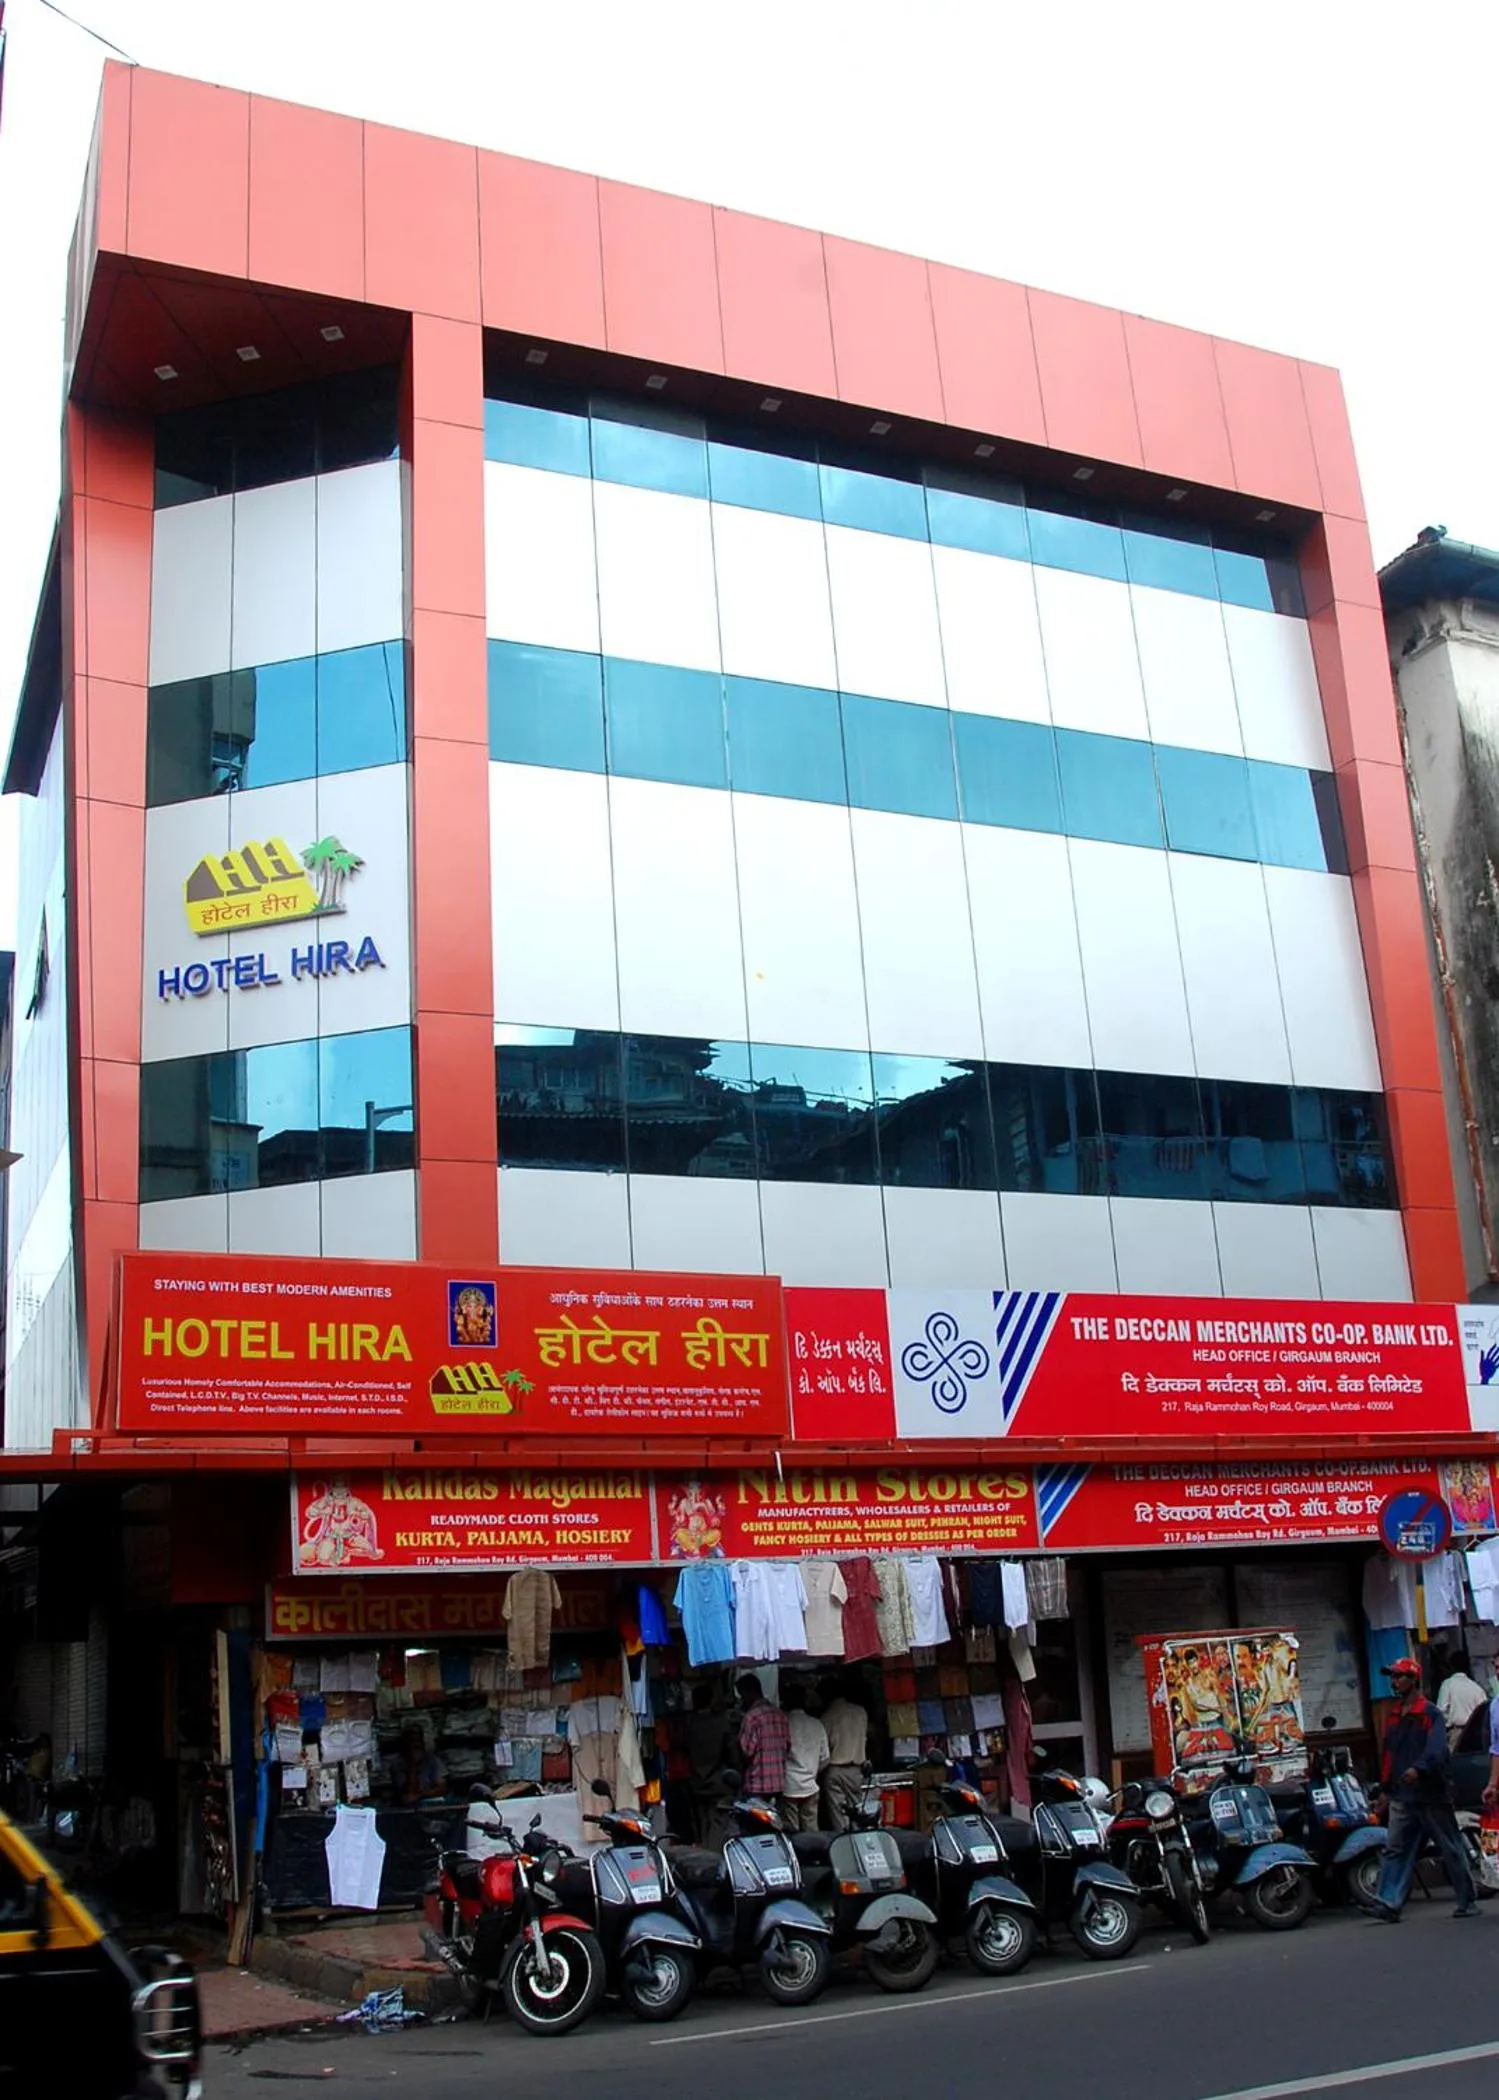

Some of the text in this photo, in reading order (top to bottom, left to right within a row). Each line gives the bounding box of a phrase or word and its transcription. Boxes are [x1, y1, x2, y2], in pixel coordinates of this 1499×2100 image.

[201, 893, 298, 926] होटेल हीरा
[158, 936, 384, 999] HOTEL HIRA
[154, 1278, 392, 1298] STAYING WITH BEST MODERN AMENITIES
[550, 1291, 588, 1308] आधुनिक
[143, 1317, 413, 1361] HOTEL HIRA
[1070, 1317, 1454, 1346] THE DECCAN MERCHANTS CO-OP. BANK LTD.
[534, 1314, 770, 1370] होटेल हीरा
[1193, 1349, 1226, 1362] HEAD
[1229, 1350, 1271, 1362] OFFICE
[1279, 1350, 1333, 1363] GIRGAUM
[1335, 1351, 1381, 1364] BRANCH
[142, 1377, 183, 1386] Luxurious
[184, 1378, 214, 1388] Homely
[215, 1379, 263, 1388] Comfortable
[397, 1382, 411, 1390] Self
[1121, 1372, 1140, 1393] दि
[1144, 1372, 1201, 1393] डेक्कन
[1263, 1373, 1293, 1393] को.
[1368, 1374, 1423, 1394] लिमिटेड
[231, 1391, 245, 1401] Big
[150, 1403, 175, 1412] Direct
[176, 1404, 217, 1414] Telephone
[239, 1405, 264, 1413] Above
[265, 1405, 298, 1414] facilities
[313, 1406, 347, 1414] available
[348, 1406, 356, 1414] in
[357, 1406, 376, 1414] each
[1184, 1402, 1204, 1414] Raja
[1205, 1402, 1251, 1412] Rammohan
[1252, 1402, 1268, 1414] Roy
[1330, 1402, 1361, 1411] Mumbai
[1113, 1464, 1145, 1481] THE
[1149, 1463, 1213, 1481] DECCAN
[1217, 1461, 1310, 1480] MERCHANTS
[1403, 1457, 1431, 1474] LTD.
[382, 1469, 643, 1509] Kalidas Maganlal
[737, 1467, 1029, 1504] Nitin Stores
[1185, 1484, 1218, 1497] HEAD
[1221, 1484, 1262, 1496] OFFICE
[1271, 1482, 1325, 1495] GIRGAUM
[1327, 1481, 1373, 1493] BRANCH
[855, 1504, 931, 1516] WHOLESALERS
[933, 1504, 941, 1513] &
[944, 1503, 995, 1513] RETAILERS
[997, 1503, 1011, 1512] OF
[1135, 1502, 1153, 1523] दि
[431, 1513, 599, 1526] READYMADE CLOTH STORES
[741, 1521, 775, 1533] GENTS
[777, 1521, 814, 1533] KURTA,
[815, 1520, 861, 1531] PAIJAMA,
[864, 1518, 902, 1530] SALWAR
[905, 1518, 928, 1529] SUIT,
[973, 1515, 1002, 1526] NIGHT
[1005, 1514, 1027, 1526] SUIT,
[395, 1529, 632, 1548] KURTA, PAIJAMA, HOSIERY
[753, 1528, 1017, 1546] FANCY HOSIERY & ALL TYPES OF DRESSES AS PER ORDER
[1164, 1532, 1184, 1543] 217,
[1186, 1532, 1205, 1545] Raja
[1207, 1530, 1253, 1541] Rammohan
[1256, 1530, 1271, 1541] Roy
[1273, 1529, 1287, 1538] Rd.
[1327, 1526, 1359, 1536] Mumbai
[434, 1556, 450, 1567] Raja
[492, 1556, 504, 1565] Roy
[552, 1553, 579, 1562] Mumbai
[275, 1581, 433, 1632] कालीदास
